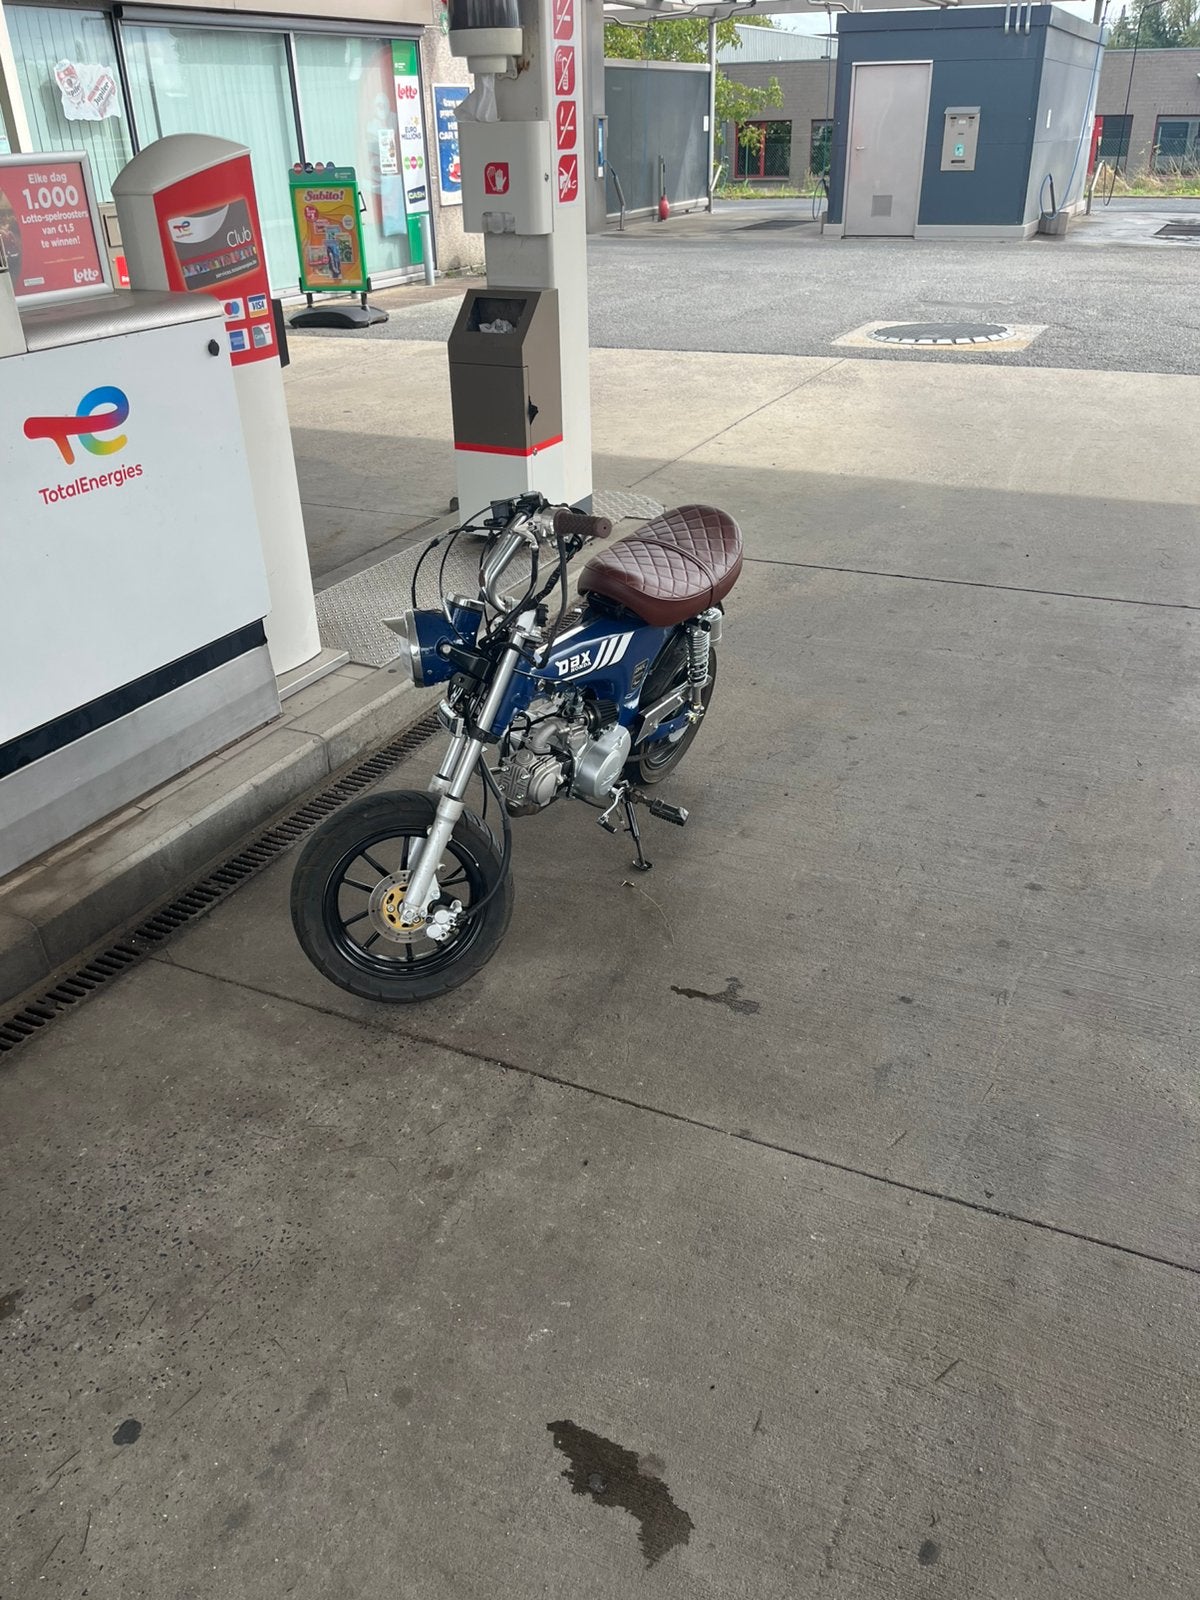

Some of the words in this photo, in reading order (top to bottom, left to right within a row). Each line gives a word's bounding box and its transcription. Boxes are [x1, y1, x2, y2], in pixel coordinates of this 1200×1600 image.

[401, 131, 422, 140] MILLIONS
[405, 126, 417, 134] EURO
[27, 173, 48, 184] Elke
[50, 172, 68, 184] dag
[22, 185, 79, 210] 1.000
[305, 190, 344, 201] Subito!
[408, 191, 425, 200] CASH
[21, 210, 89, 224] Lotto-spelroosters
[42, 225, 57, 235] van
[41, 239, 50, 249] te
[51, 235, 81, 248] winnen!
[226, 226, 252, 248] Club
[252, 300, 265, 311] VISA
[38, 463, 143, 505] TotalEnergies
